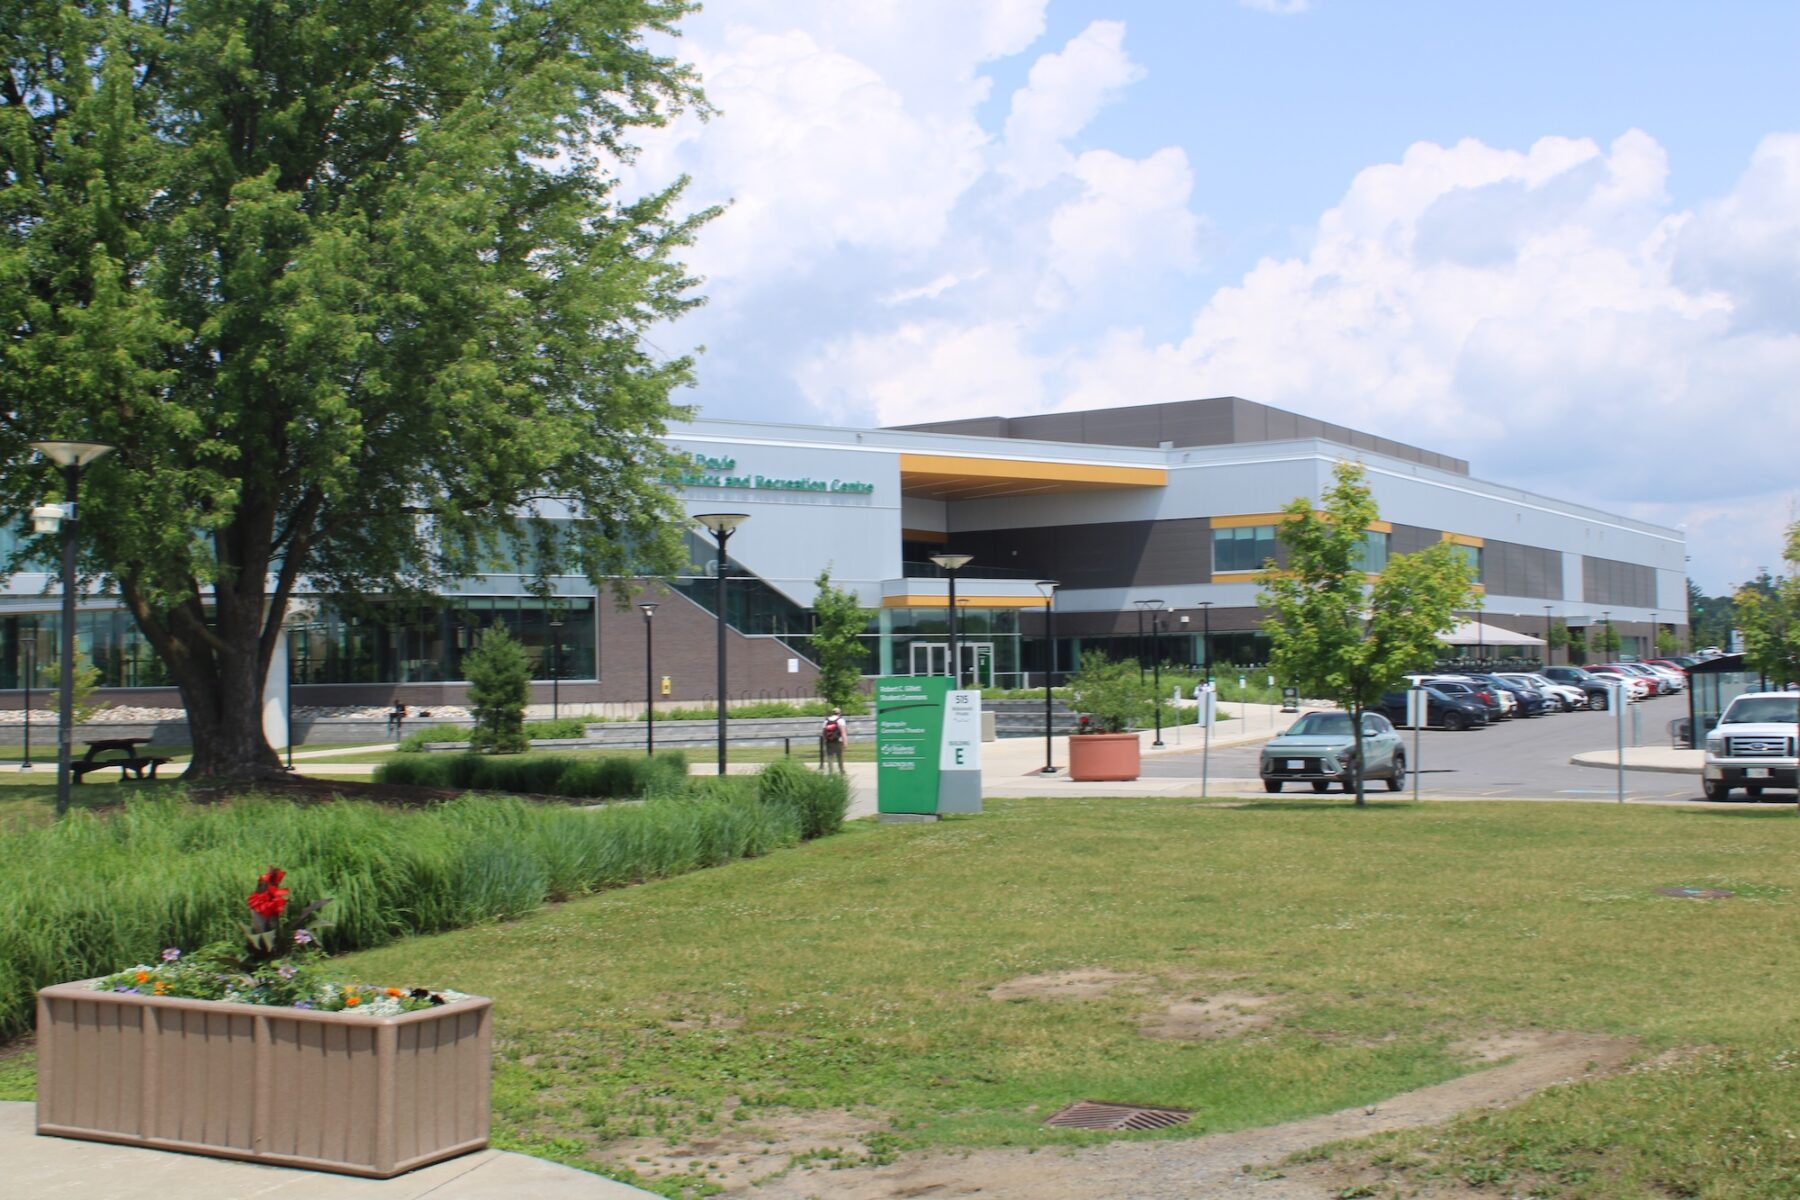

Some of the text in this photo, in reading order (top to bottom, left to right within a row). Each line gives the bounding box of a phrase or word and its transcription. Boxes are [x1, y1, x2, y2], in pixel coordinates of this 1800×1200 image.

[725, 474, 751, 489] and
[755, 475, 826, 492] Recreation
[831, 479, 874, 494] Centre
[956, 748, 964, 765] E
